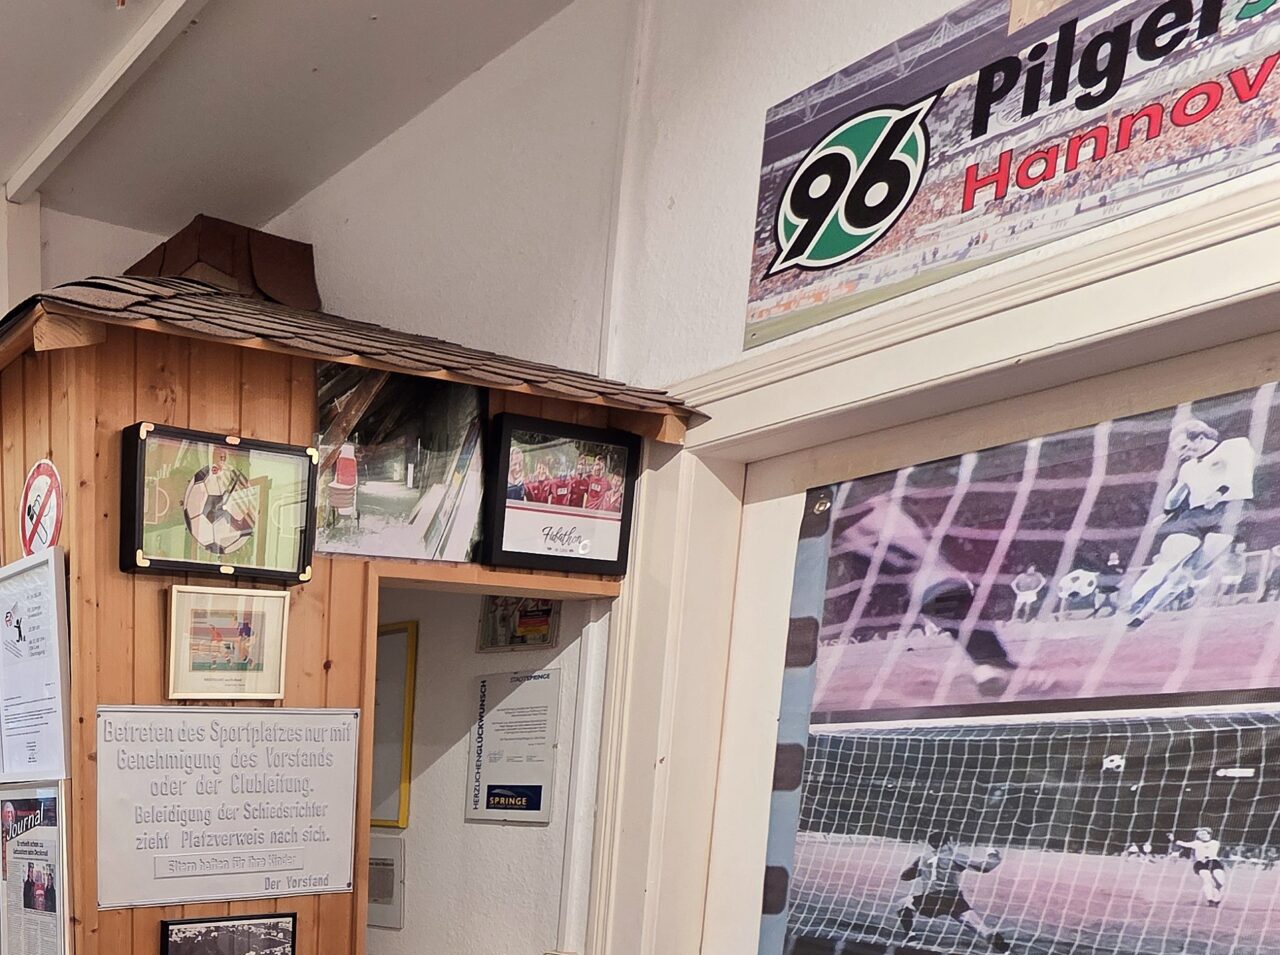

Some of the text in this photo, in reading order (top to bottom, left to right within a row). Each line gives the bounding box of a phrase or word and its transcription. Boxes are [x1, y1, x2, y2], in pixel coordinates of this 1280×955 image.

[770, 98, 930, 270] 96
[103, 719, 352, 748] Betreten des Sportplatzes nur mit
[117, 746, 334, 775] Genehmigung des Vorstands
[150, 772, 315, 798] oder der Clubleitung.
[134, 800, 329, 826] Beleidigung der Schiedsrichter
[489, 796, 528, 806] SPRINGE
[6, 801, 45, 841] Journal
[135, 824, 330, 850] zieht Platzverweis nach sich.
[264, 873, 330, 891] Der Vorstand
